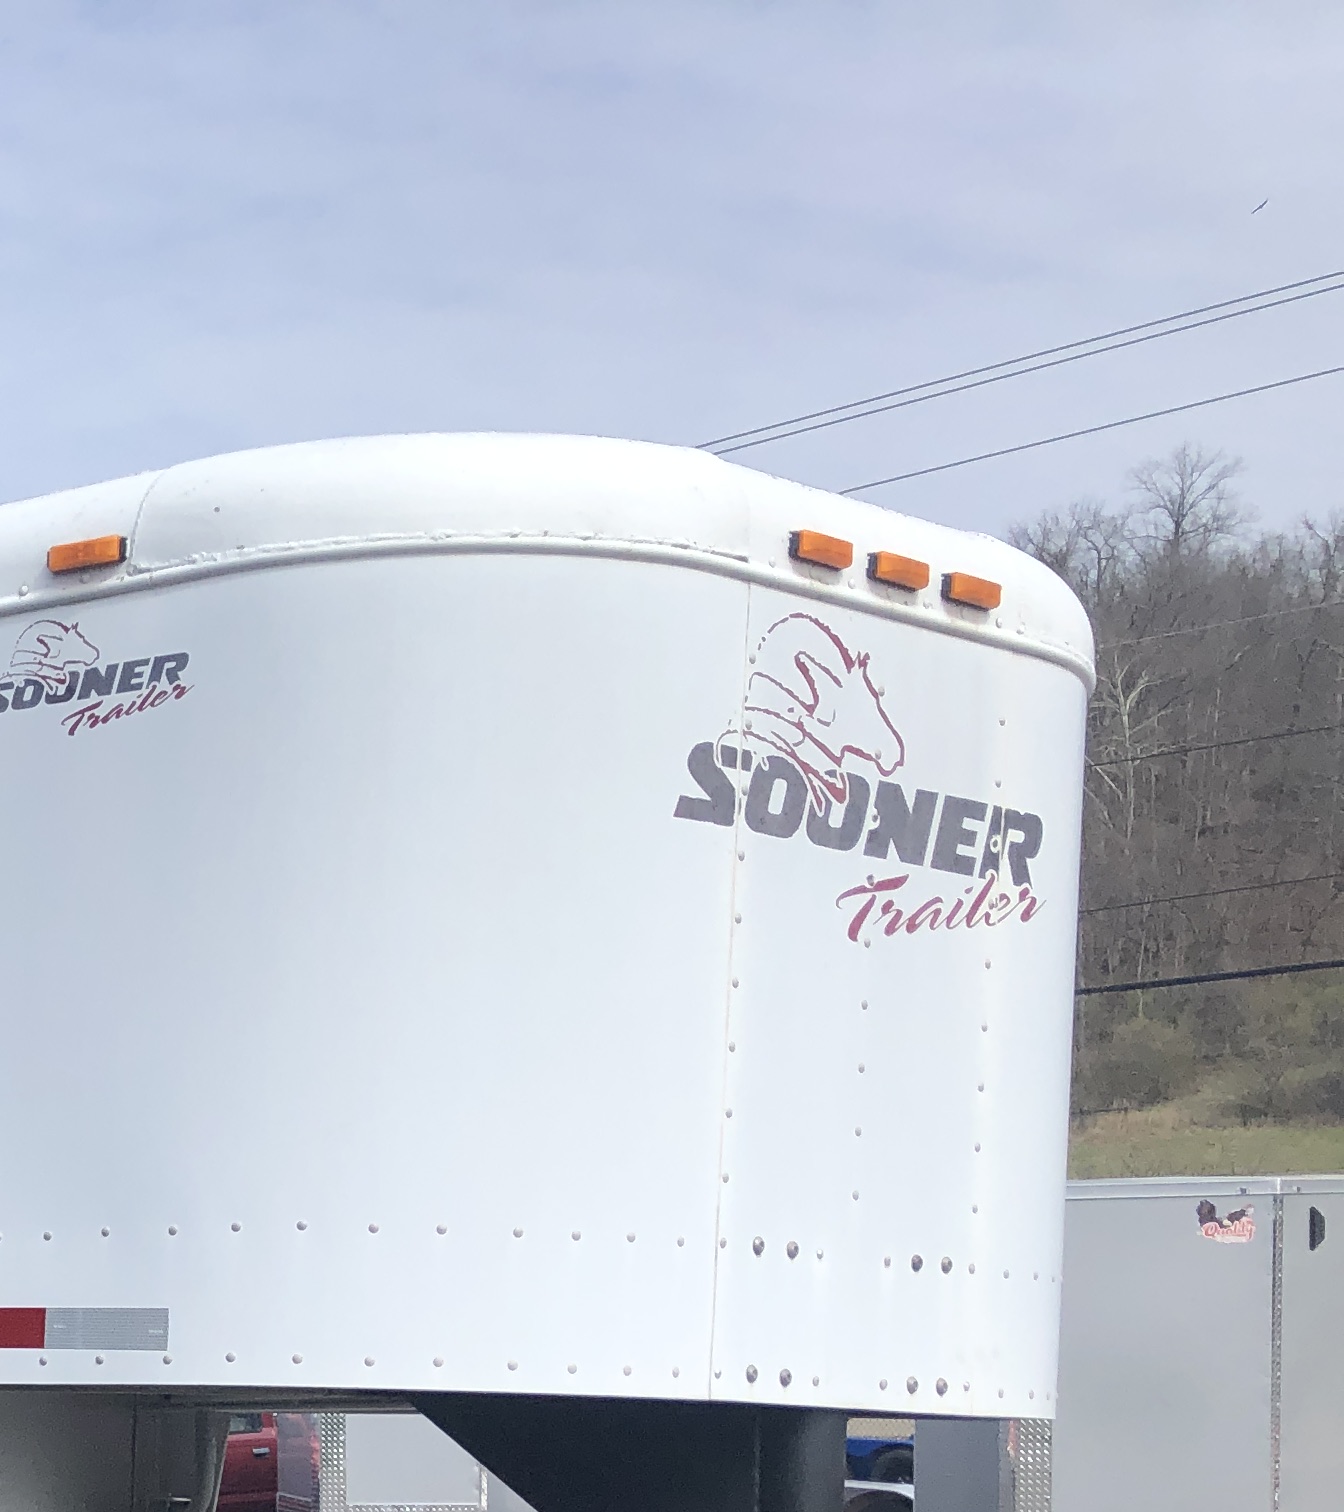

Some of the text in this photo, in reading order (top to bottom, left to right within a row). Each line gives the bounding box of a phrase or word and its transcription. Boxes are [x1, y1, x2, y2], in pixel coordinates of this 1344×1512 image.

[60, 682, 195, 737] Trailer
[672, 741, 1044, 889] SOONER
[835, 871, 1047, 943] Trailer
[1203, 1219, 1254, 1240] Quality
